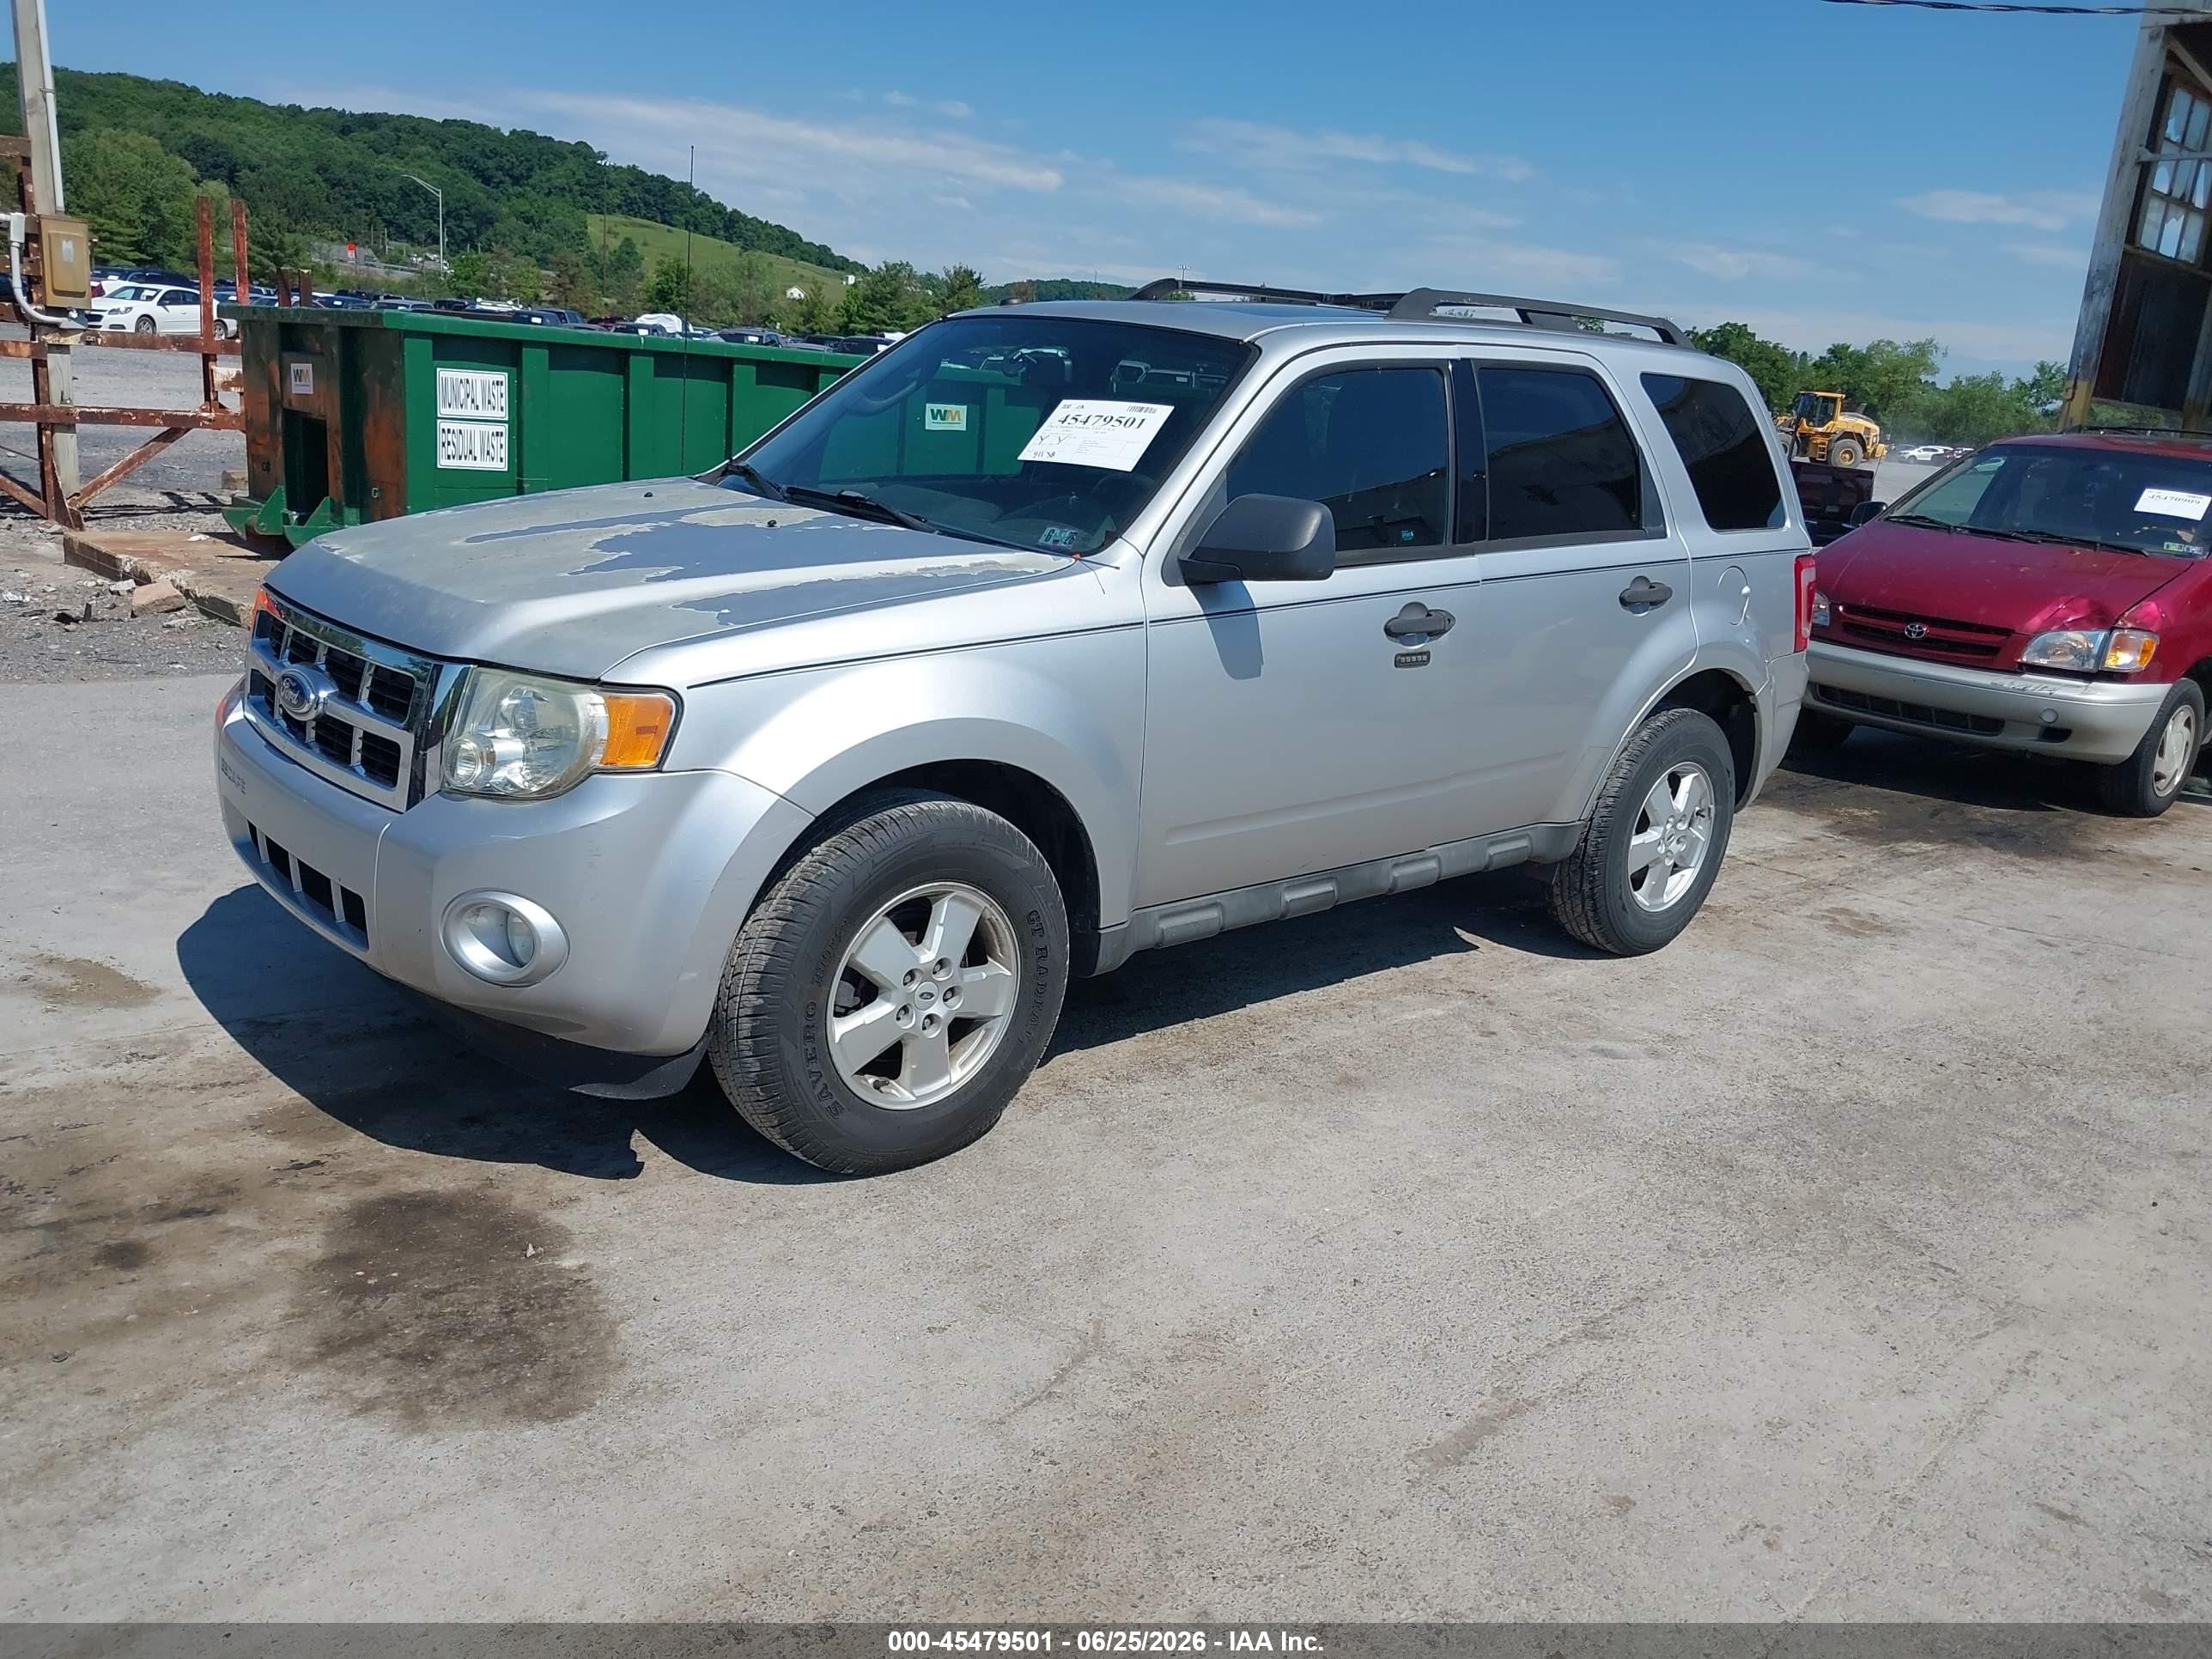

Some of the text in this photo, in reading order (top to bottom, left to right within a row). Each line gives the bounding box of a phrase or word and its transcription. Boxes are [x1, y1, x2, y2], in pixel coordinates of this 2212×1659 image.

[293, 368, 310, 383] WM
[441, 376, 504, 412] MUNICIPAL WASTE
[930, 408, 963, 422] WM
[1058, 414, 1147, 430] 45479501
[441, 428, 504, 463] RESIDUAL WASTE
[280, 678, 301, 705] Ford
[1027, 909, 1045, 938] GT
[803, 1000, 846, 1120] SAVERO
